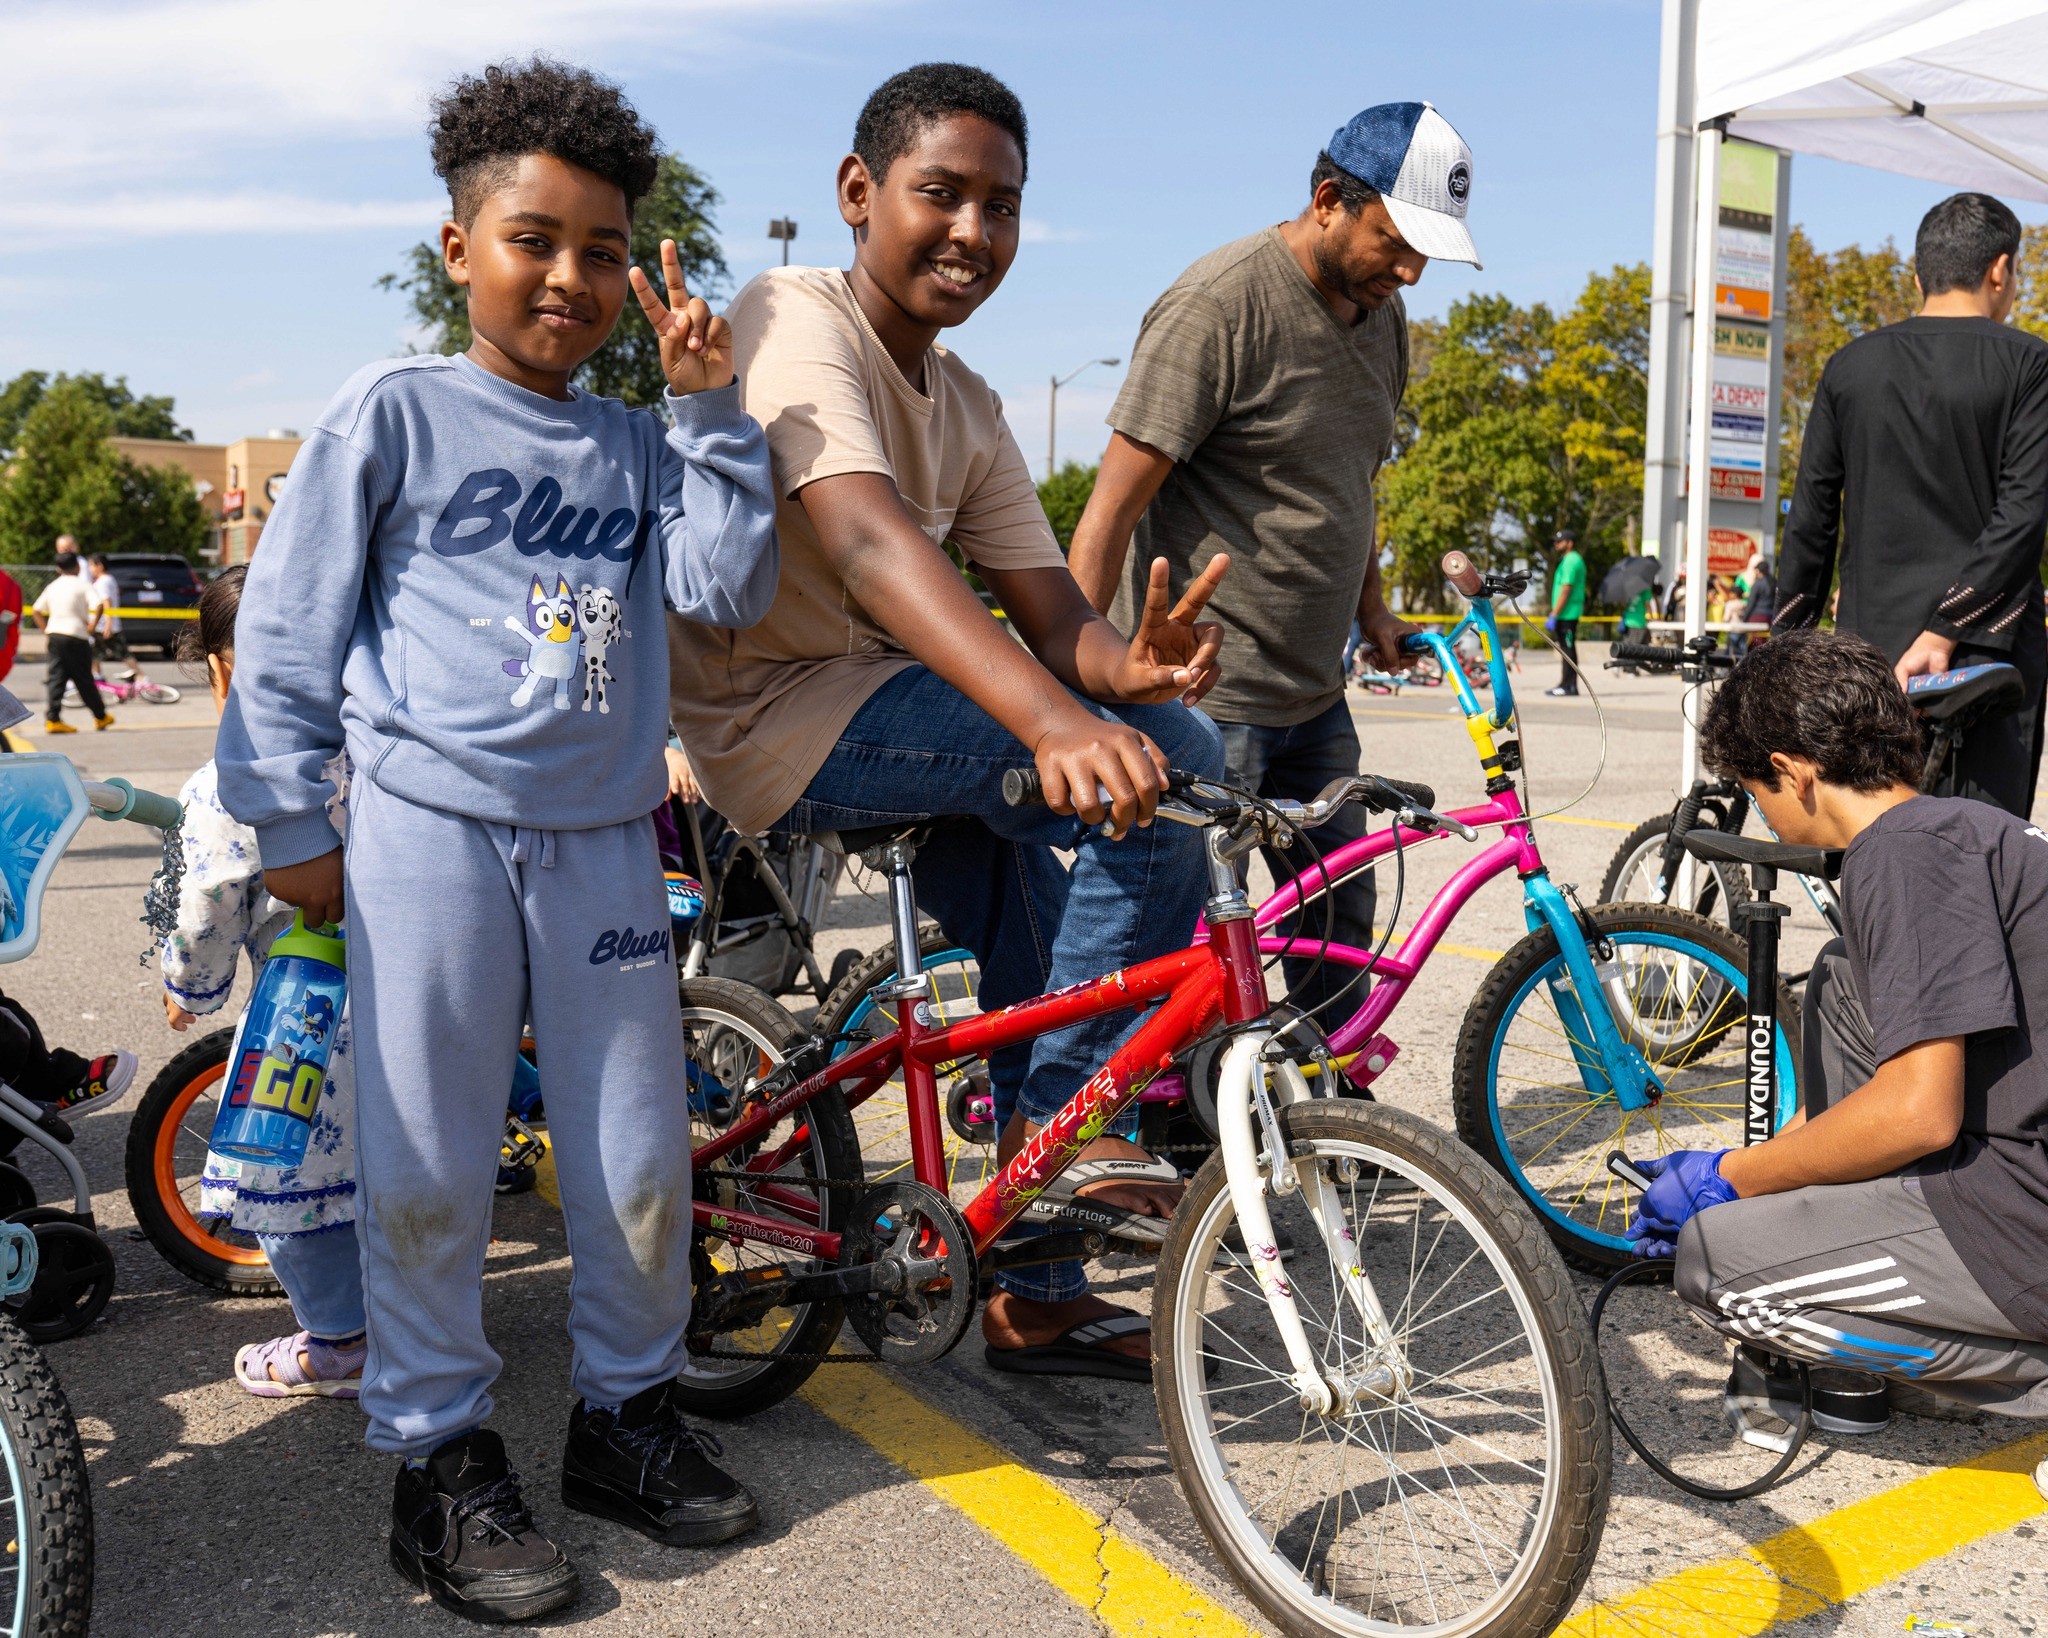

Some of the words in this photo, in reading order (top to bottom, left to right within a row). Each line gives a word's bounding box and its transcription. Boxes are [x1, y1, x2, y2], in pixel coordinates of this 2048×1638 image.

[1736, 332, 1766, 348] NOW
[1728, 386, 1765, 407] DEPOT
[1708, 541, 1751, 560] STAURANT
[470, 618, 491, 627] BEST
[589, 926, 670, 965] Bluey
[620, 964, 633, 972] BEST
[636, 959, 656, 969] BUDDIES
[250, 1055, 323, 1119] GO
[1260, 1094, 1273, 1126] PROMAX
[1053, 1204, 1076, 1218] FLIP
[1077, 1208, 1113, 1225] FLOPS
[711, 1213, 813, 1254] Margherita20
